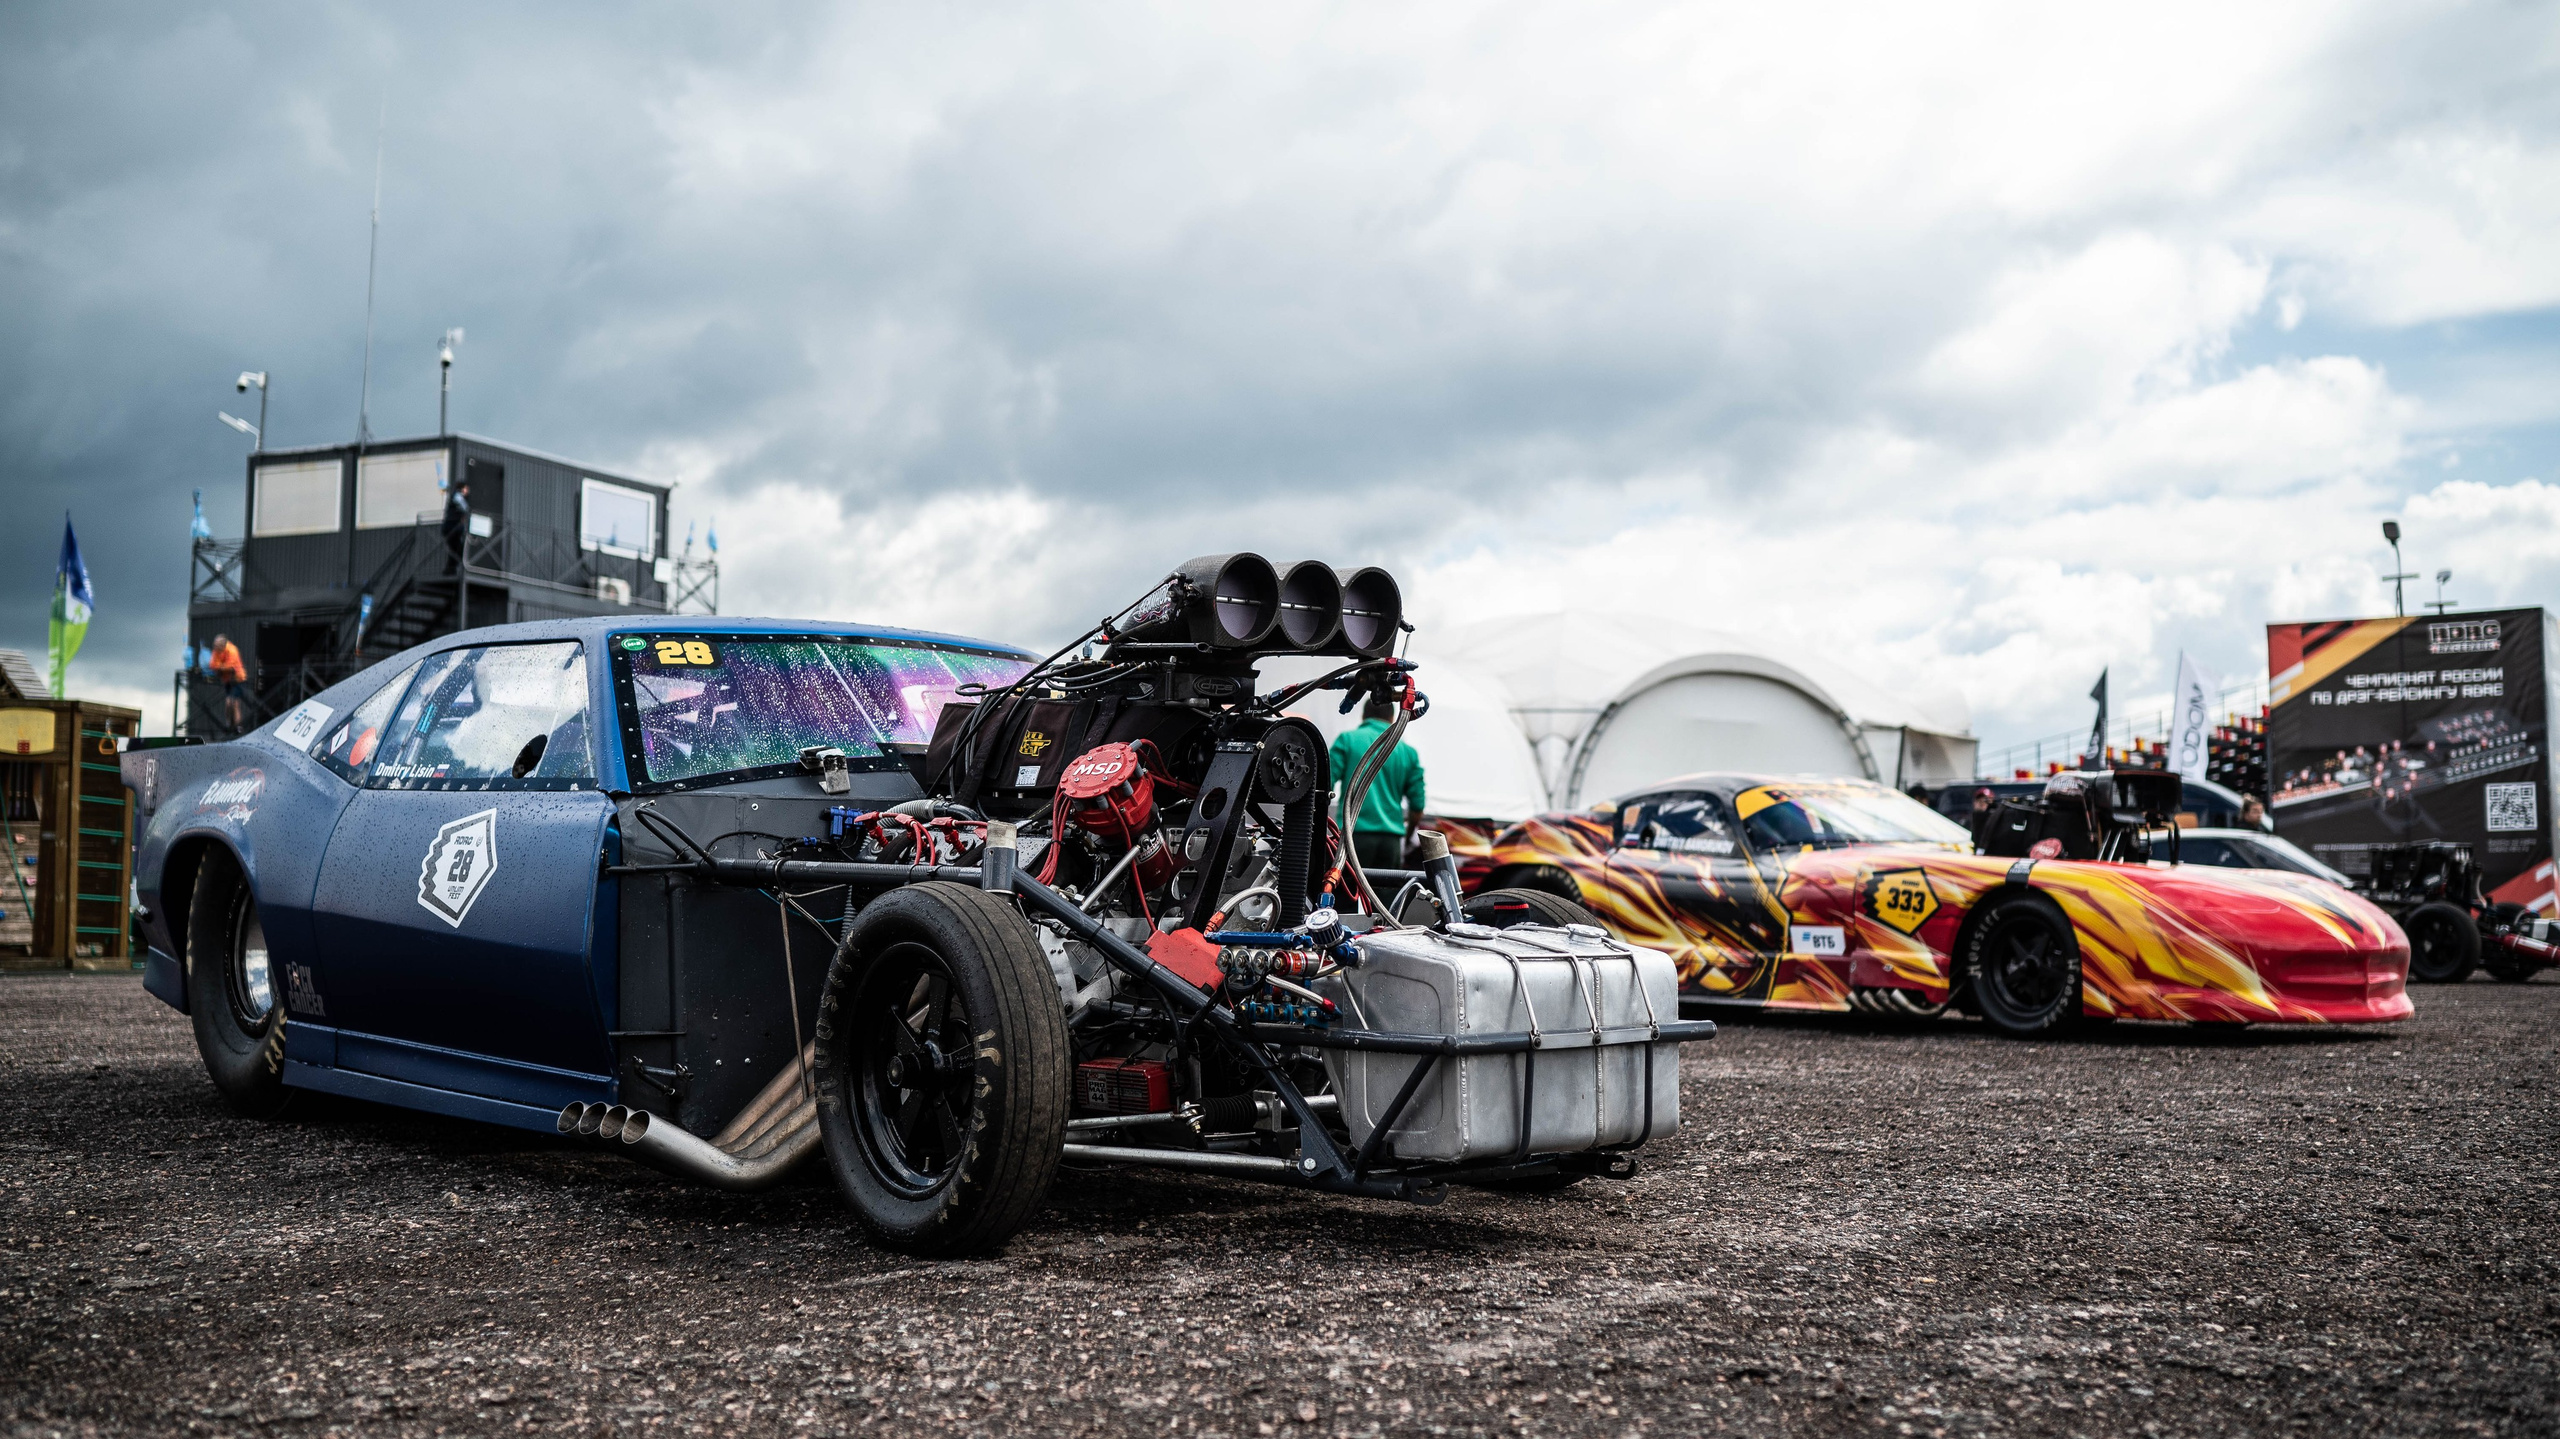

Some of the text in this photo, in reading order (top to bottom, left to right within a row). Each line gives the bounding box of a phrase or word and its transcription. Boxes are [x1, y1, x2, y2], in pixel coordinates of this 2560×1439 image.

[655, 641, 714, 665] 28
[2345, 667, 2503, 688] ЧЕМПИОНАТ РОССИИ
[2310, 691, 2332, 705] ПО
[2462, 682, 2503, 698] RDRC
[375, 762, 435, 780] Dmitry Lisin
[1072, 762, 1122, 776] MSD
[447, 849, 475, 882] 28
[1887, 887, 1926, 914] 333
[1812, 934, 1836, 949] ВТБ
[1089, 1081, 1105, 1089] PRO
[1091, 1093, 1105, 1103] 44
